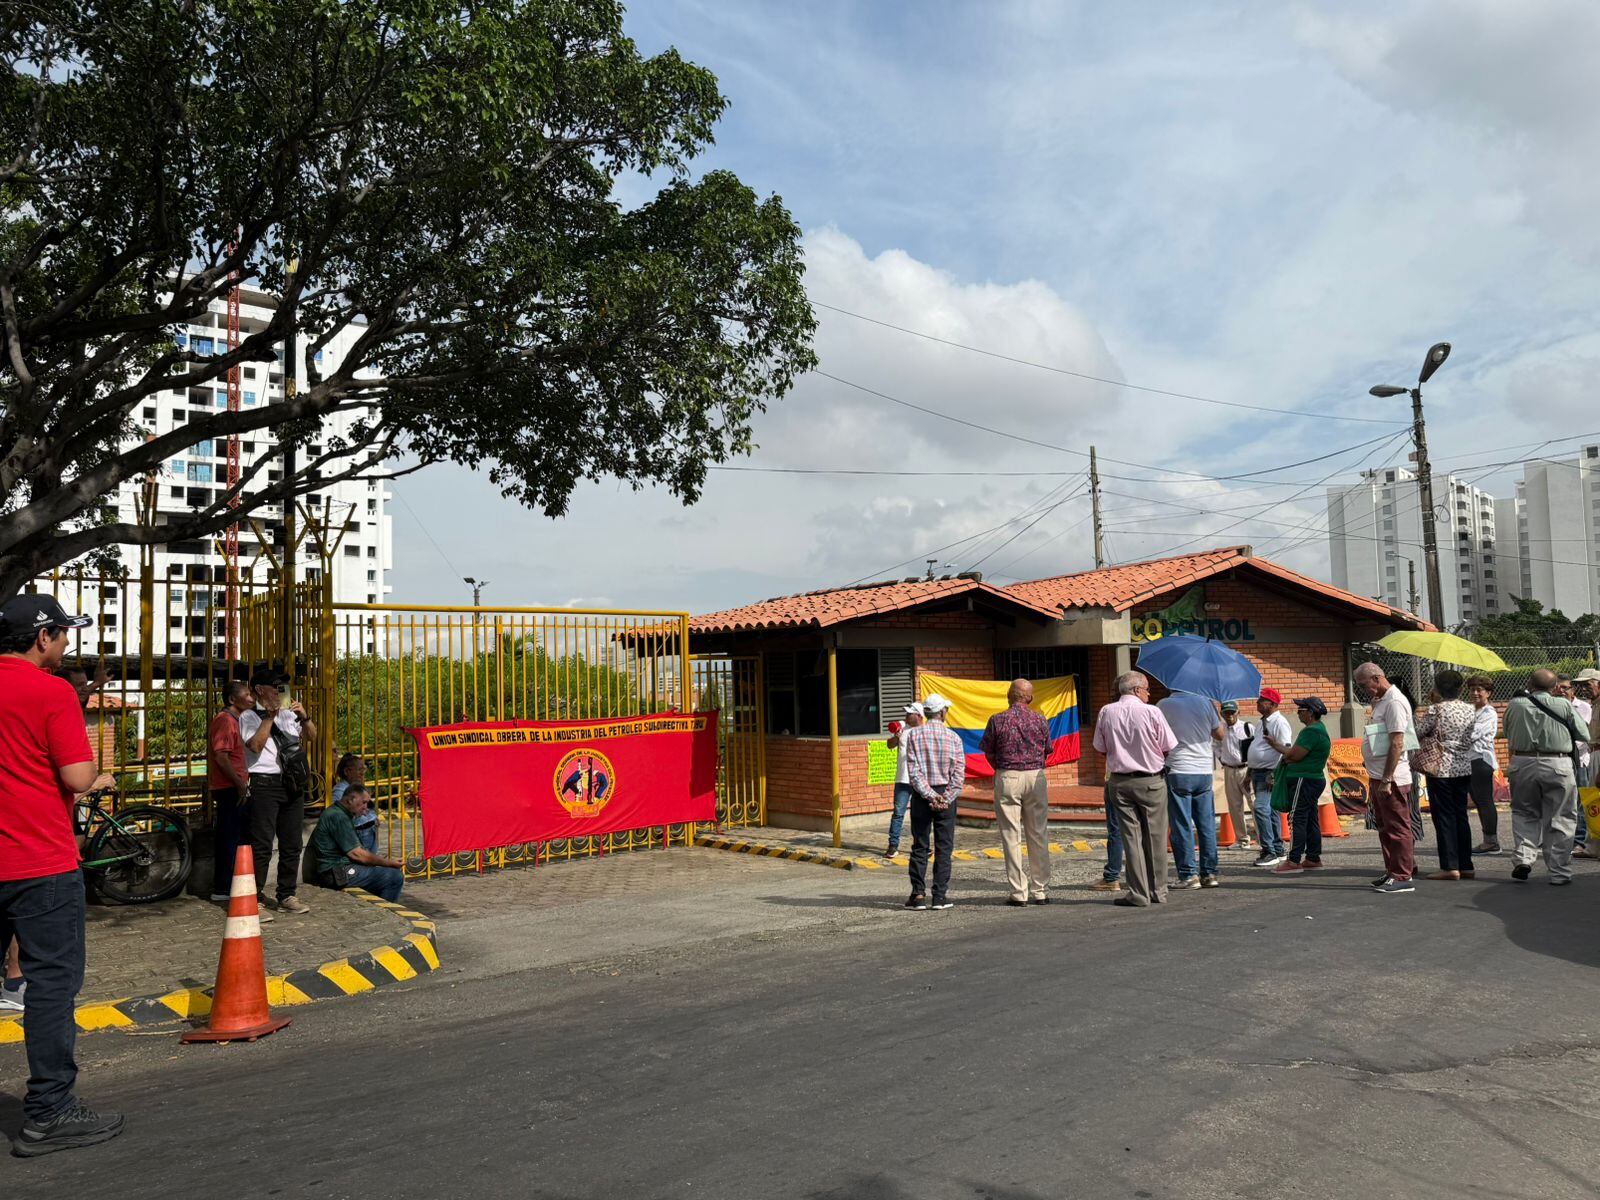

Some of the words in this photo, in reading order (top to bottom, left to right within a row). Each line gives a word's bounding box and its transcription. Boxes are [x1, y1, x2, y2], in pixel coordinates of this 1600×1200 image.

[33, 619, 54, 627] Santander
[432, 735, 457, 746] UNION
[458, 732, 494, 744] SINDICAL
[496, 731, 526, 743] OBRERA
[530, 731, 540, 741] DE
[542, 731, 552, 741] LA
[554, 728, 592, 741] INDUSTRIA
[594, 727, 607, 738] DEL
[609, 723, 642, 736] PETROLEO
